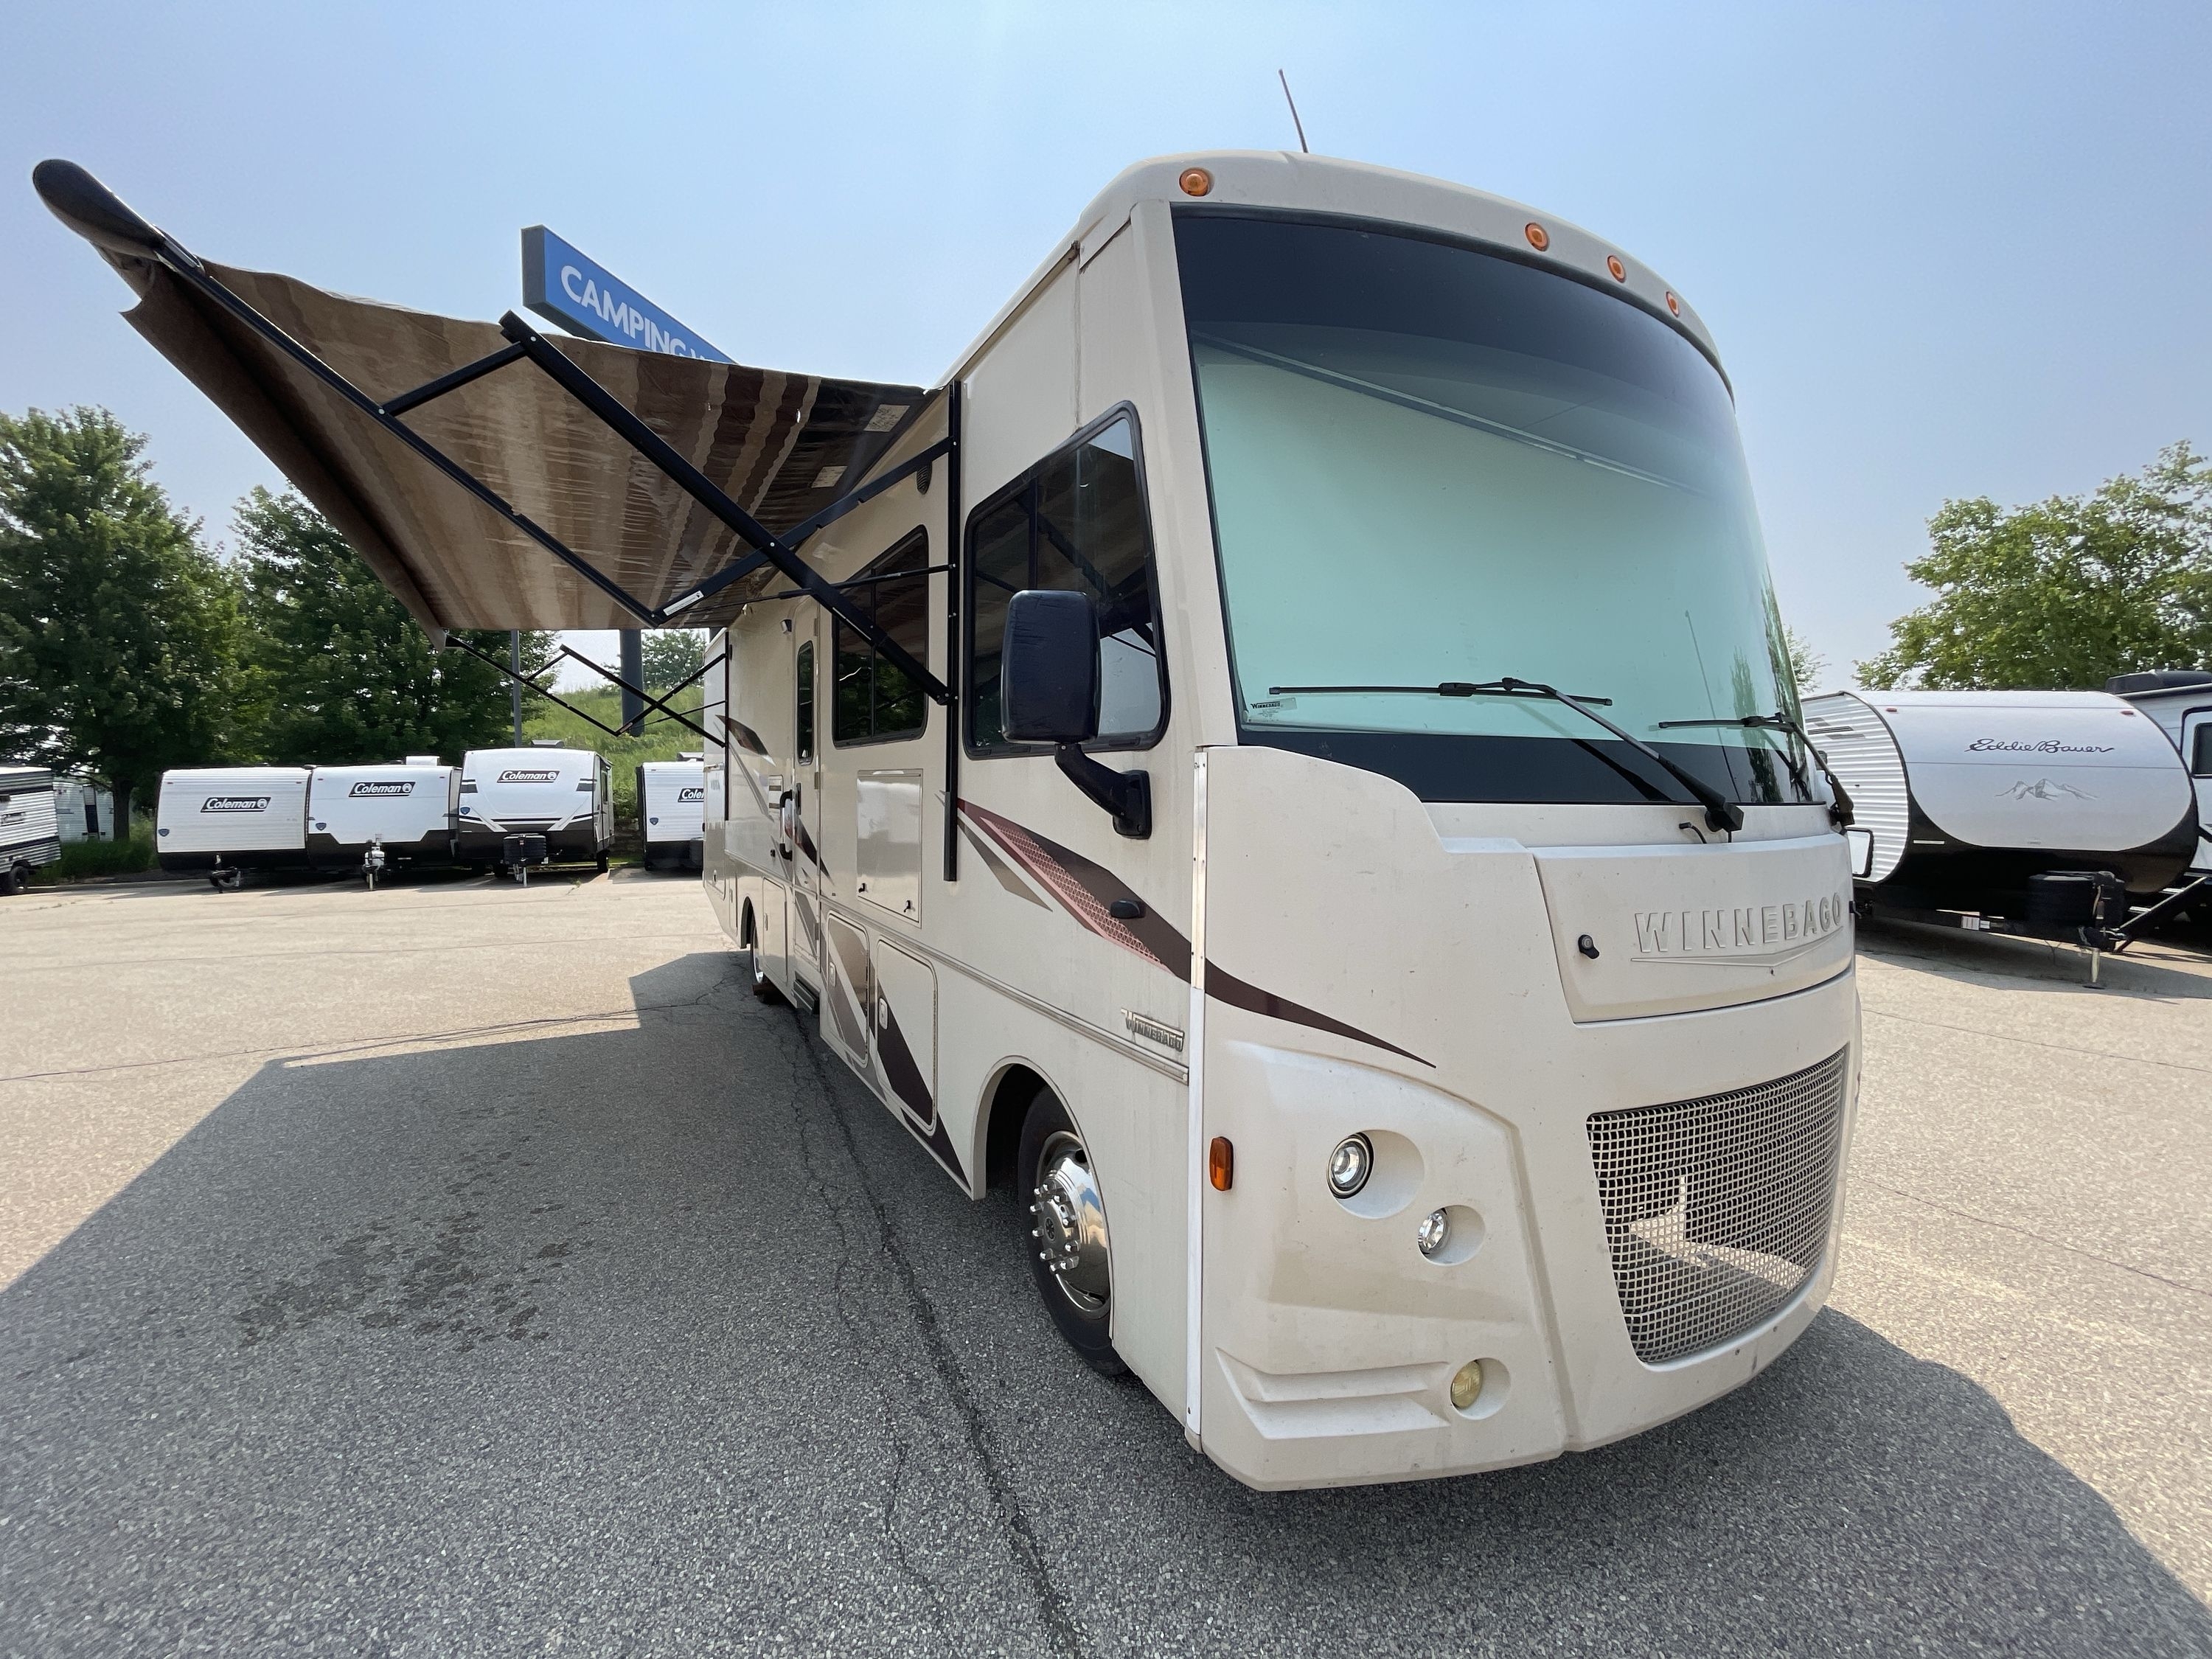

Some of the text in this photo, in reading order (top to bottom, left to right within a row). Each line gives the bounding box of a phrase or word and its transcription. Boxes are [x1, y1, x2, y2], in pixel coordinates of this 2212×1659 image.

[561, 265, 686, 357] CAMPING
[1964, 738, 2115, 754] Eddie Bauer
[501, 771, 547, 780] Coleman
[354, 783, 402, 794] Coleman
[206, 798, 257, 810] Coleman
[1634, 892, 1843, 953] WINNEBAGO
